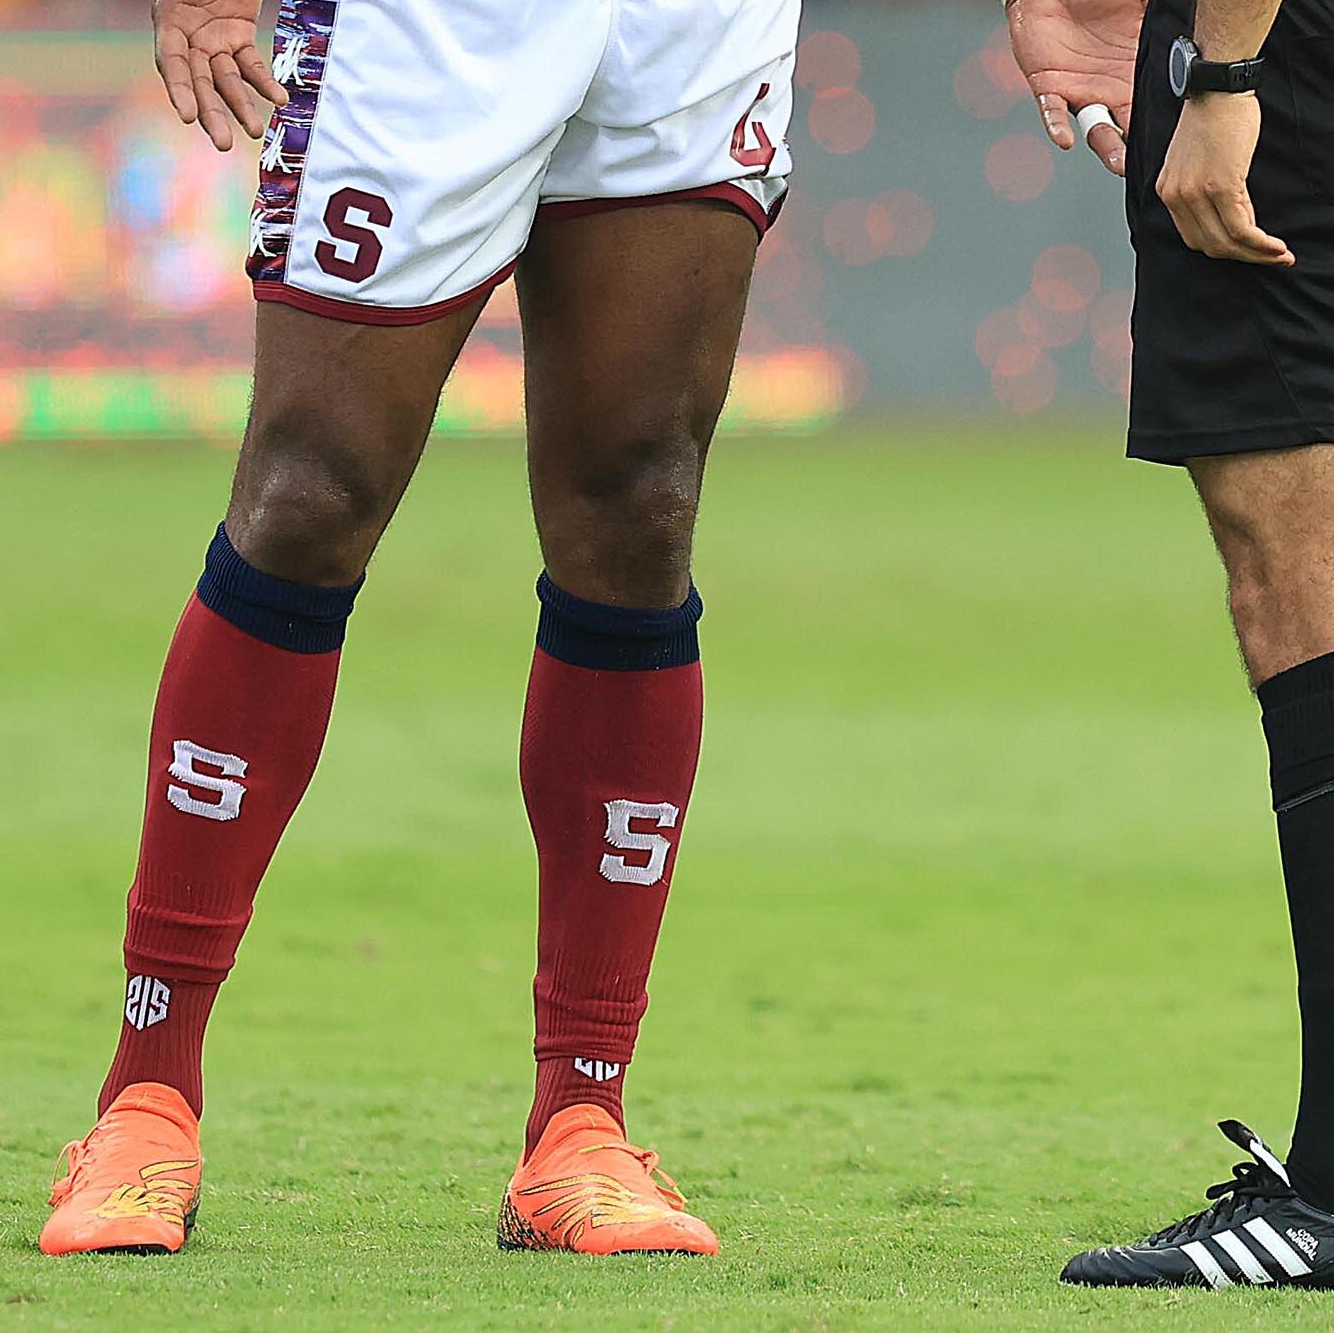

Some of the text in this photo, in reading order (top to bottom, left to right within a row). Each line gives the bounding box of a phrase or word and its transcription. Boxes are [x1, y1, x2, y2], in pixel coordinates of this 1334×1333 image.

[314, 186, 394, 284] S
[167, 739, 248, 822] S
[598, 798, 680, 886] S
[1297, 1228, 1319, 1250] COPA
